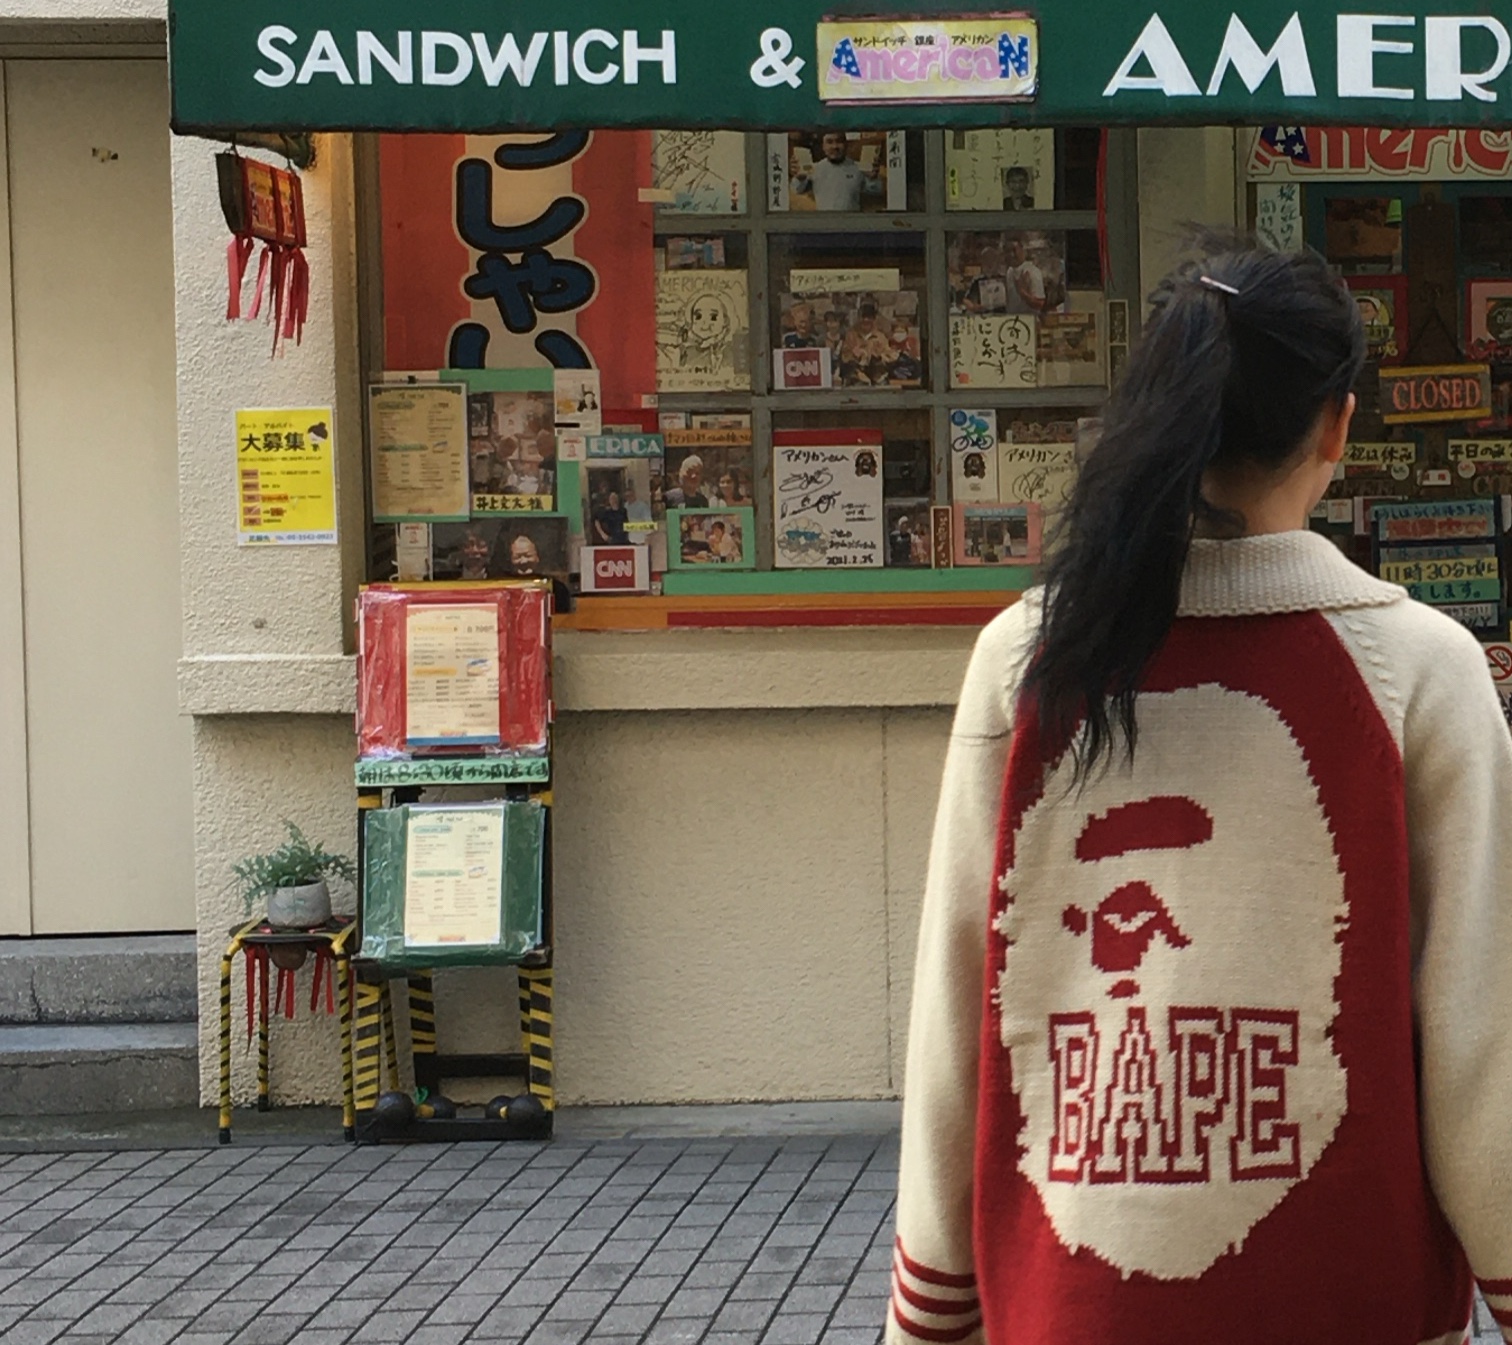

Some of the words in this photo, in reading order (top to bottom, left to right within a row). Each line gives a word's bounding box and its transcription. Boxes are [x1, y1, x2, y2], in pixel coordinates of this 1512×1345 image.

[853, 35, 907, 46] サンドイッチ
[951, 34, 994, 45] アメリカン
[253, 25, 677, 88] SANDWICH
[750, 27, 805, 89] &
[786, 361, 819, 378] CNN
[1391, 378, 1483, 411] CLOSED
[241, 431, 305, 453] 大募集
[588, 436, 661, 455] ERICA
[595, 560, 633, 578] CNN
[1049, 1006, 1300, 1184] BAPE
